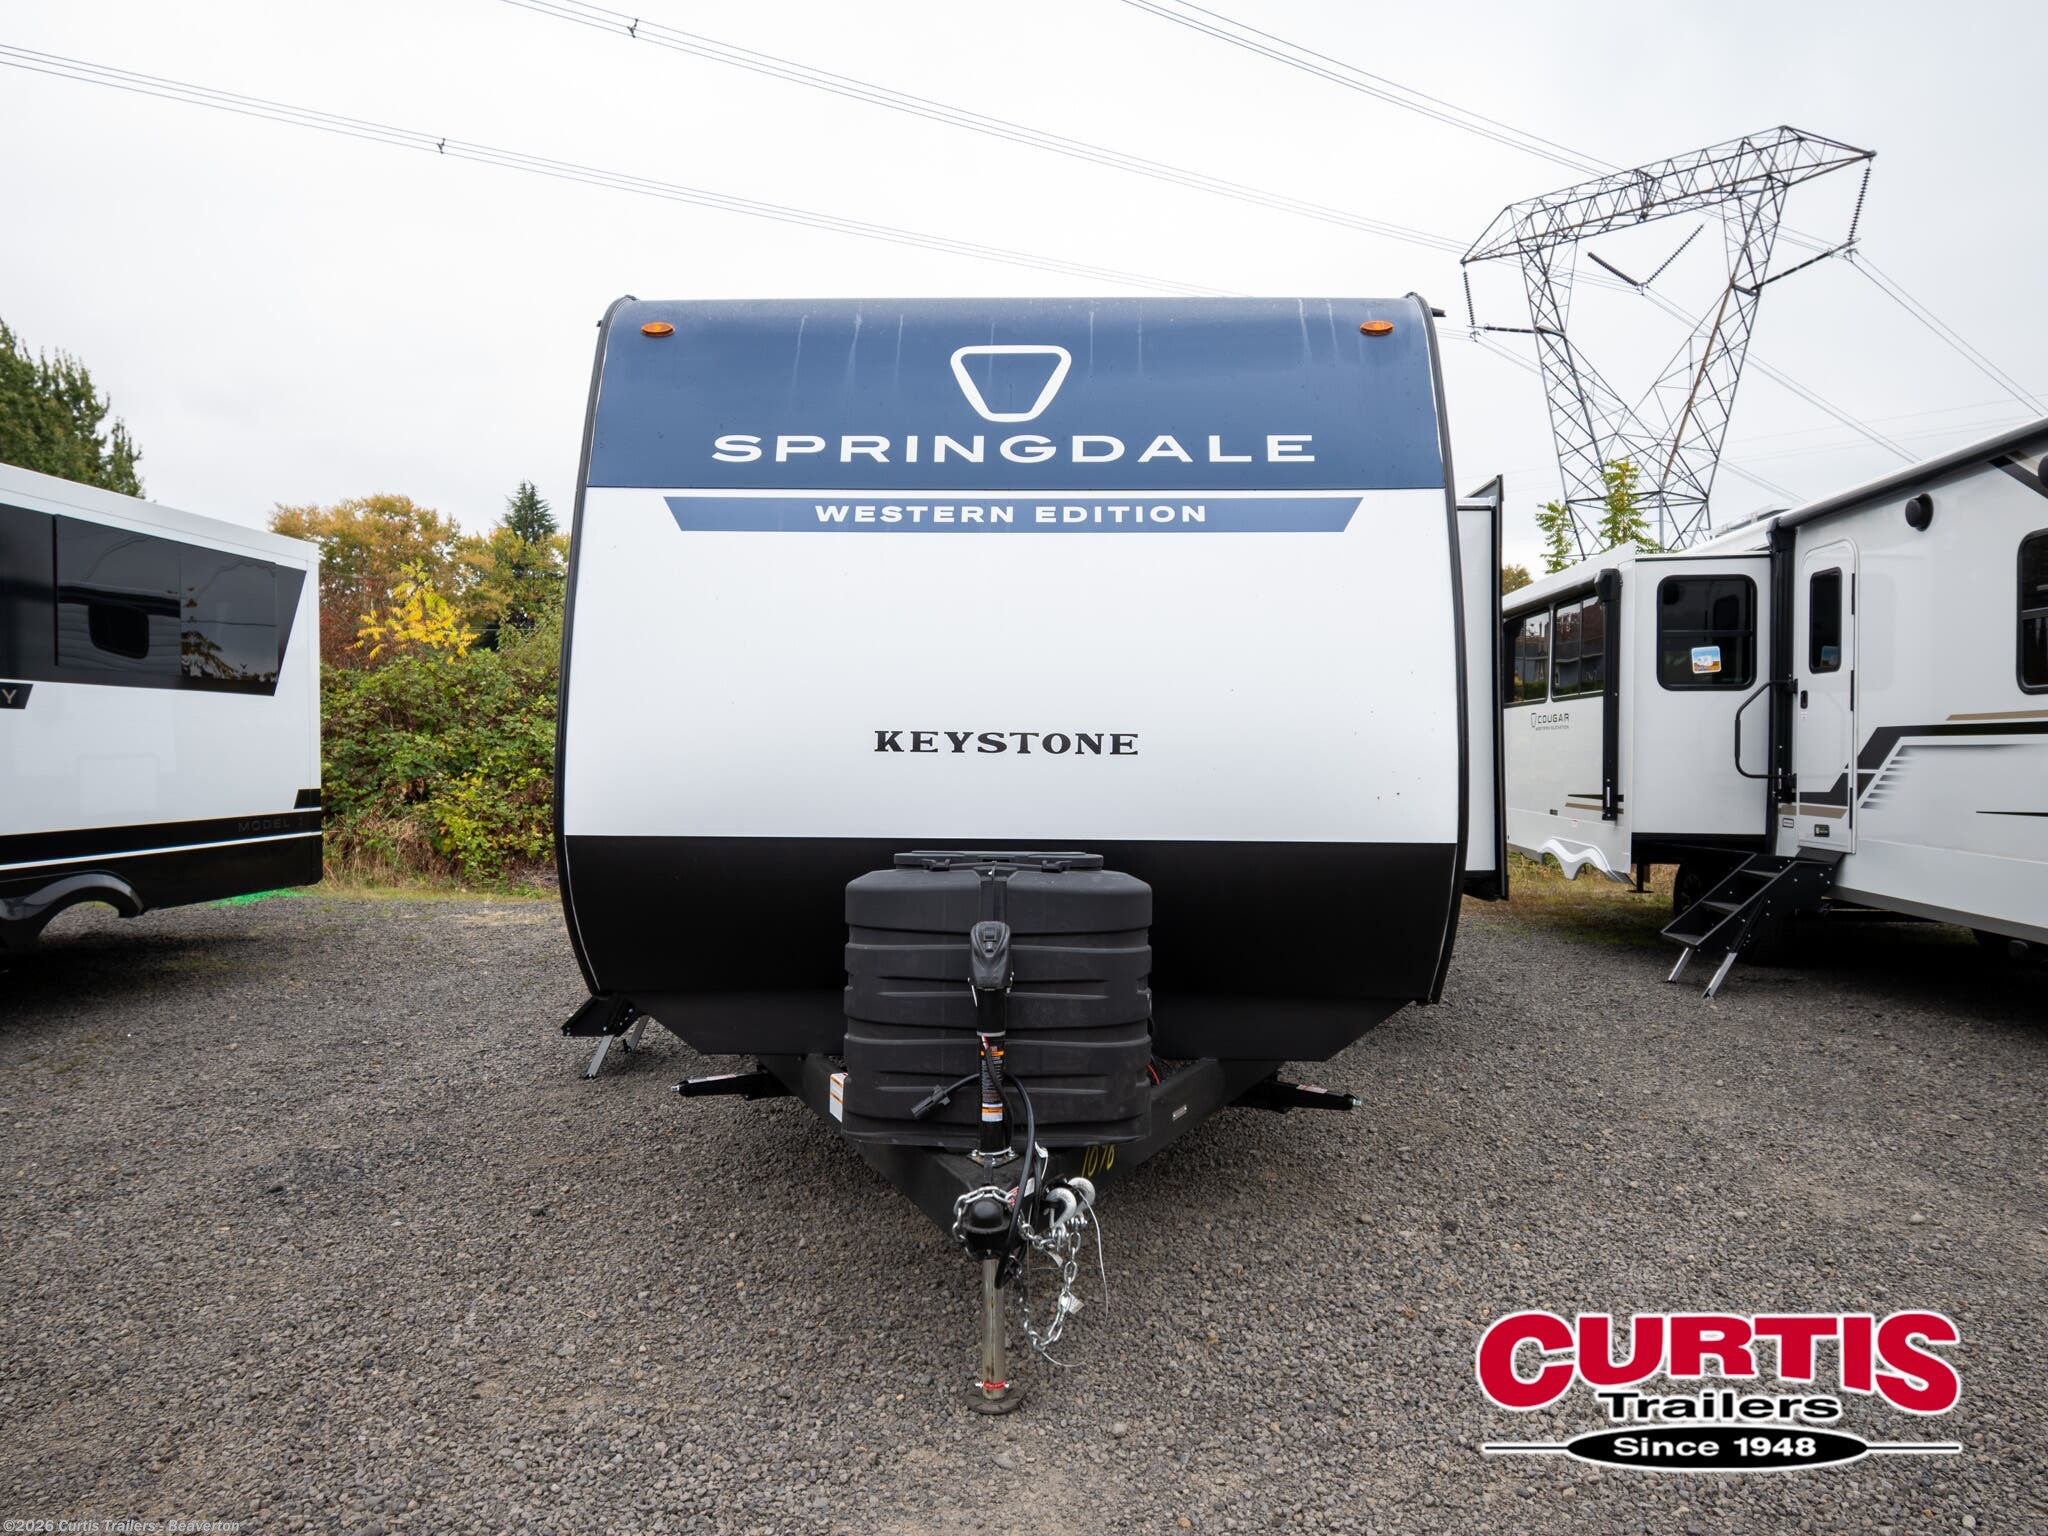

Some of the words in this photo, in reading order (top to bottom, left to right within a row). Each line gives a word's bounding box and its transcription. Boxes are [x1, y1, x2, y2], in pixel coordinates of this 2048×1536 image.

[711, 434, 1315, 463] SPRINGDALE
[814, 505, 1014, 524] WESTERN
[1035, 505, 1207, 523] EDITION
[1537, 712, 1570, 724] COUGAR
[874, 730, 1139, 755] KEYSTONE
[238, 816, 290, 832] MODEL
